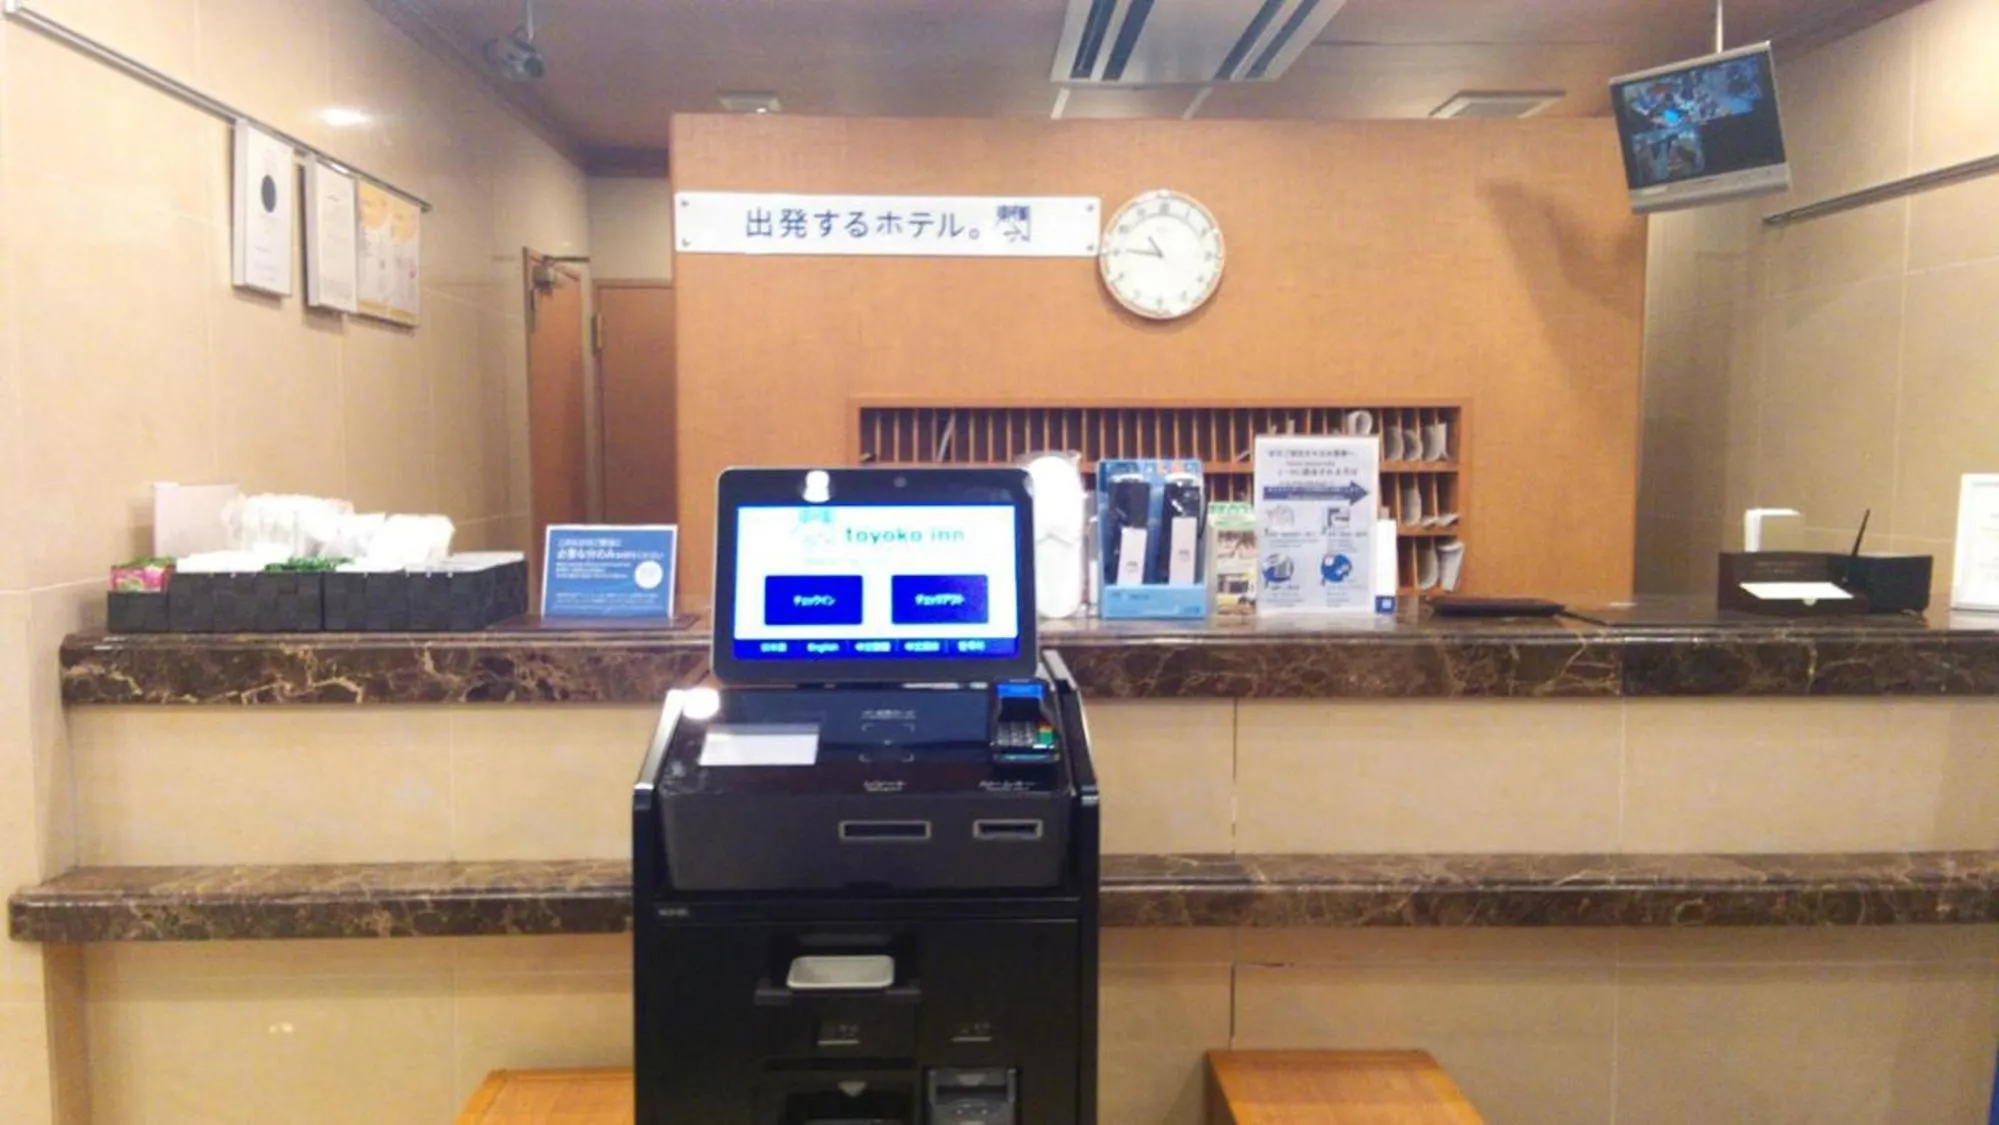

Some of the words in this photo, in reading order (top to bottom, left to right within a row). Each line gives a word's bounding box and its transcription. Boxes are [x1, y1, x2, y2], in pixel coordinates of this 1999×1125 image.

[746, 206, 980, 240] 出発するホテル。
[844, 527, 923, 545] toyoko
[930, 528, 966, 543] inn
